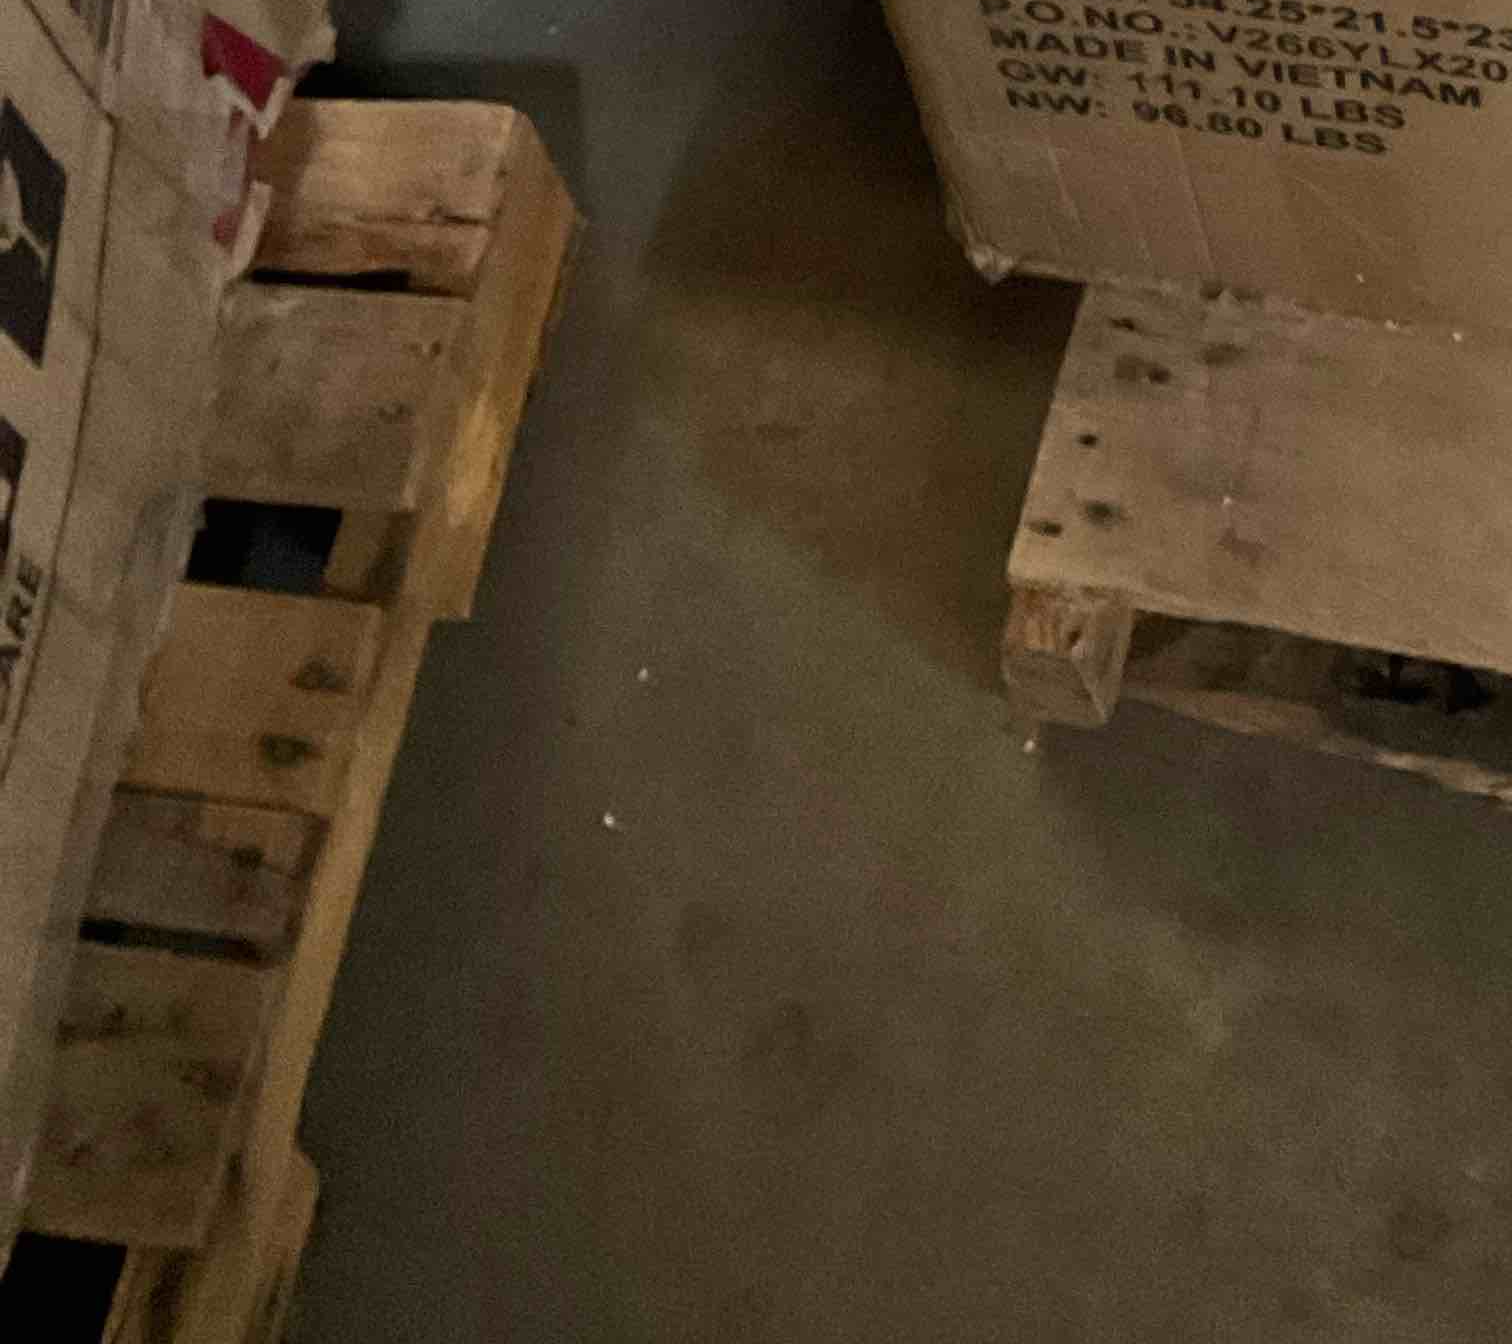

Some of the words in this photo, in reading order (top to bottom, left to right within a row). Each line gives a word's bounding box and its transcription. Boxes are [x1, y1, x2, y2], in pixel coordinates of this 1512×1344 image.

[988, 26, 1148, 63] MADE
[1164, 44, 1216, 73] IN
[1234, 53, 1483, 112] VIETNAM
[1006, 87, 1108, 118] NW:
[1281, 121, 1388, 156] LBS
[1301, 95, 1407, 131] LBS
